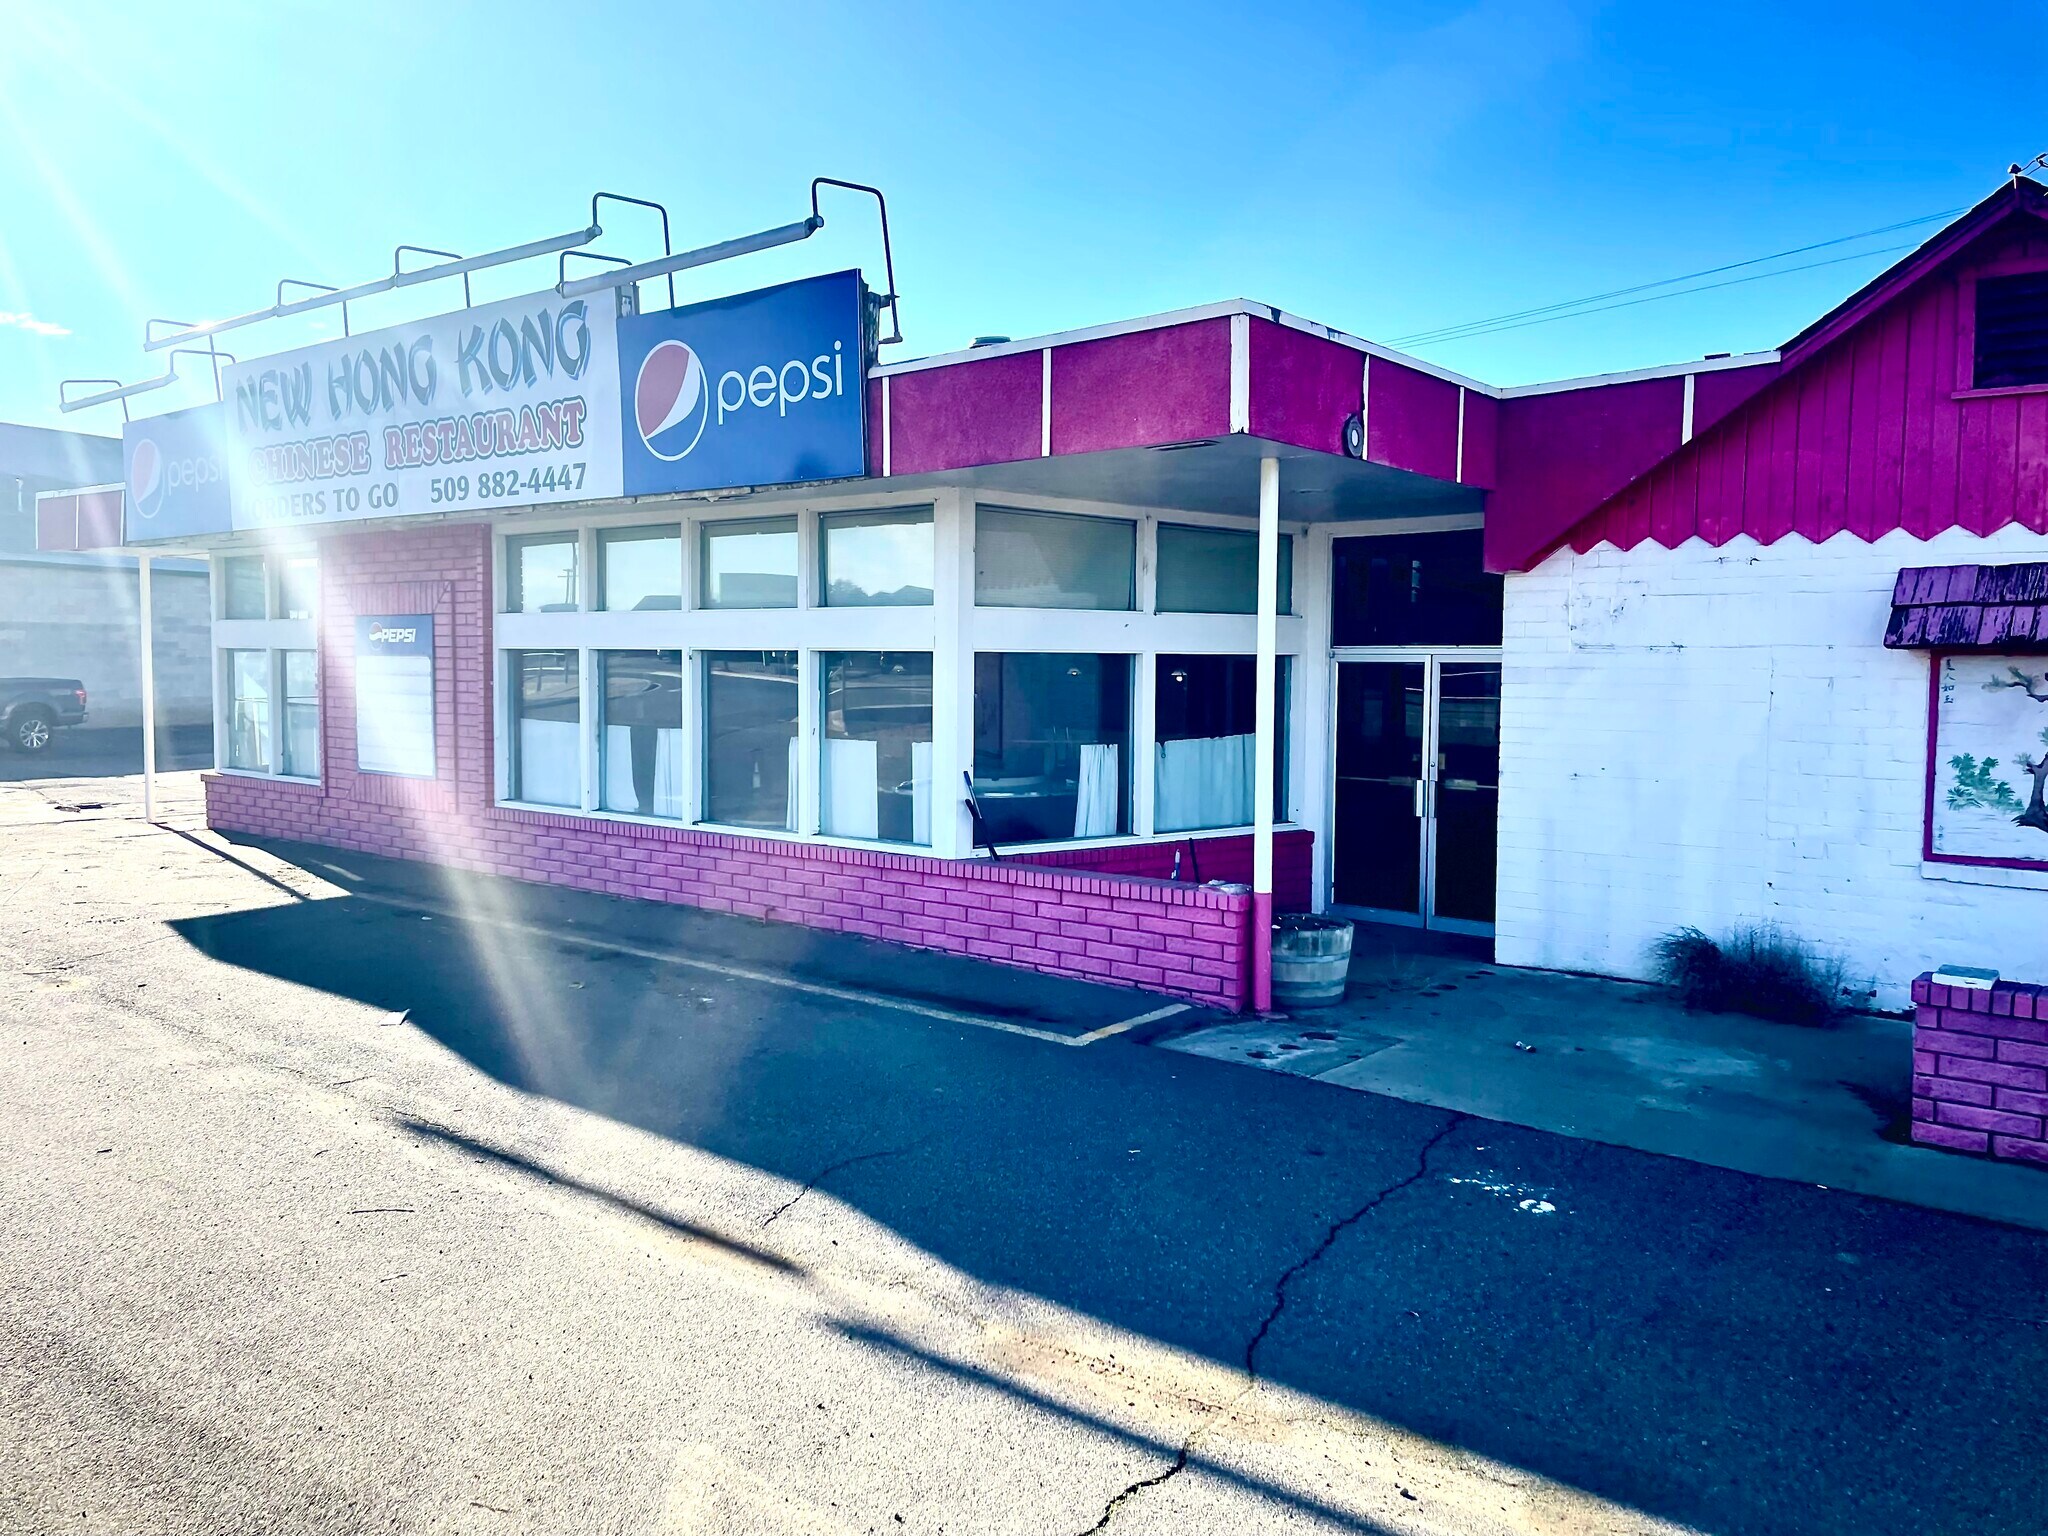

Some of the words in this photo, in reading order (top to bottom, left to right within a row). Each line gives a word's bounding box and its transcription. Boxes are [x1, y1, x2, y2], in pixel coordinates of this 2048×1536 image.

[235, 361, 313, 433] NEW
[327, 334, 437, 421] HONG
[454, 299, 592, 399] KONG
[716, 340, 843, 425] pepsi
[249, 429, 372, 486] CHINESE
[383, 395, 587, 470] RESTAURANT
[167, 456, 224, 496] pepsi
[333, 487, 360, 512] TO
[367, 482, 399, 509] GO
[430, 475, 470, 504] 509
[477, 462, 587, 499] 882-4447
[381, 628, 417, 643] PEPSI
